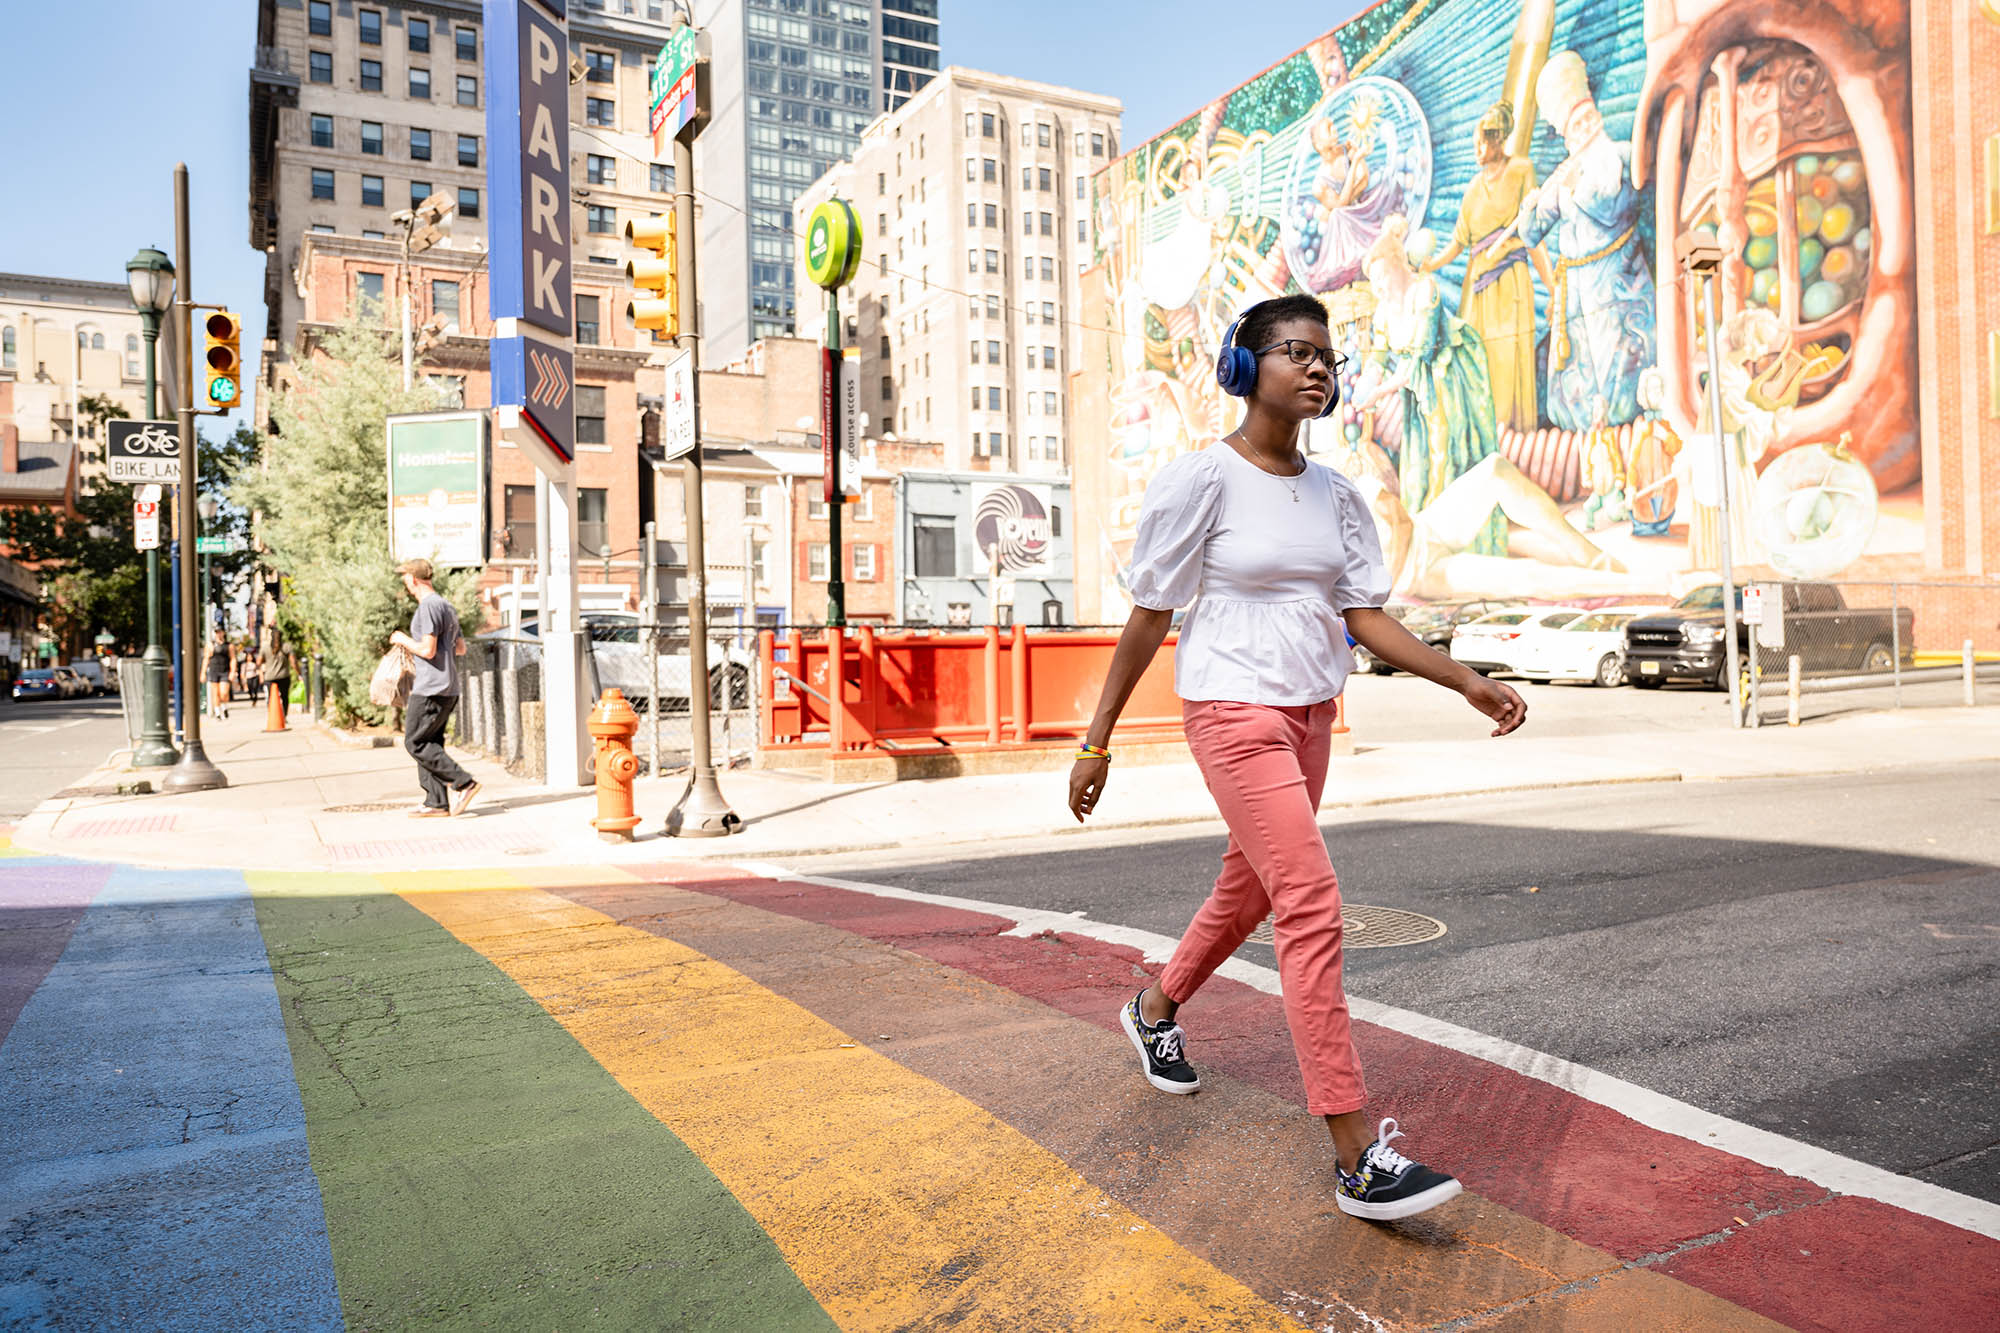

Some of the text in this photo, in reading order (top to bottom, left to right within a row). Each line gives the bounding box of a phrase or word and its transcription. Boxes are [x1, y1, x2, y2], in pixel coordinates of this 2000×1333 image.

[528, 23, 564, 318] PARK
[847, 379, 855, 415] access
[115, 462, 181, 477] BIKE LAN
